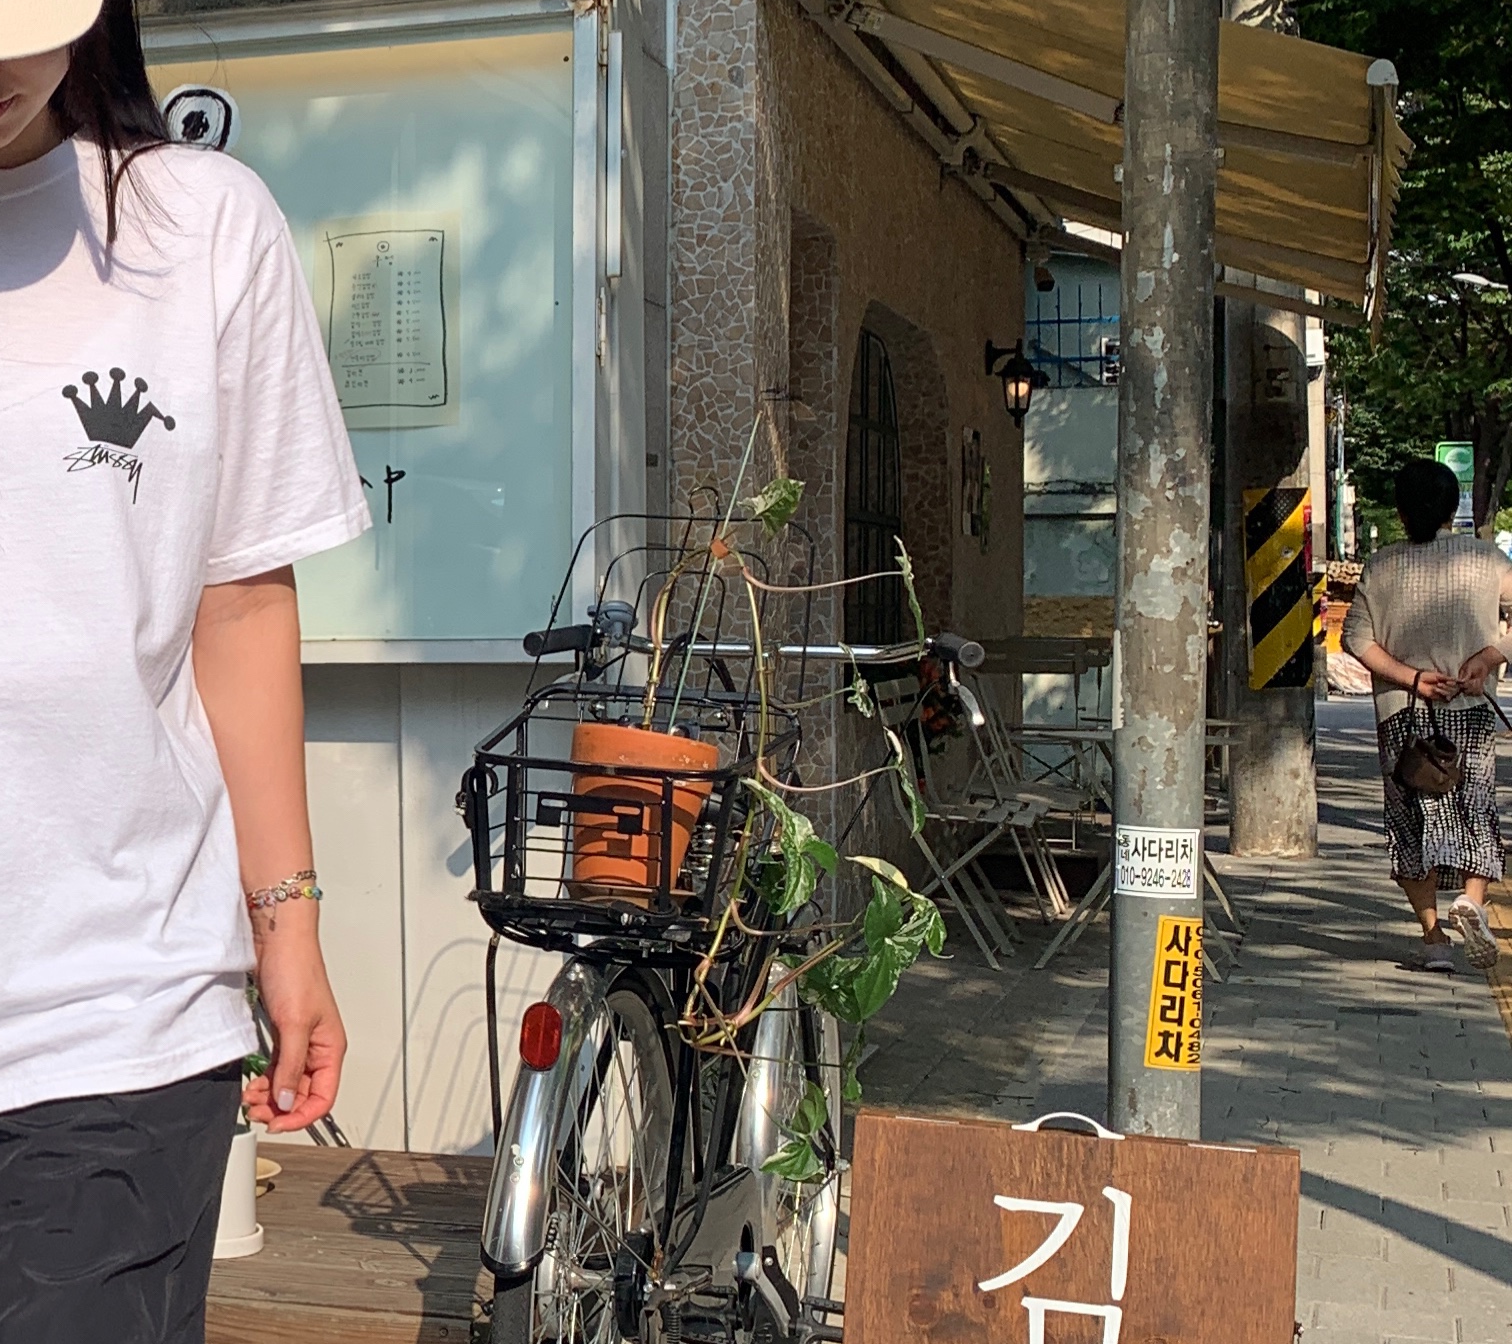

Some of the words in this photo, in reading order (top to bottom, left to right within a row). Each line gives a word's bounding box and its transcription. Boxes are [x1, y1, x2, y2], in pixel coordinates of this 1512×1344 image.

[1131, 837, 1194, 864] 사다리차
[1120, 865, 1192, 889] 010-9246-2428
[1154, 924, 1192, 1063] 사다리차
